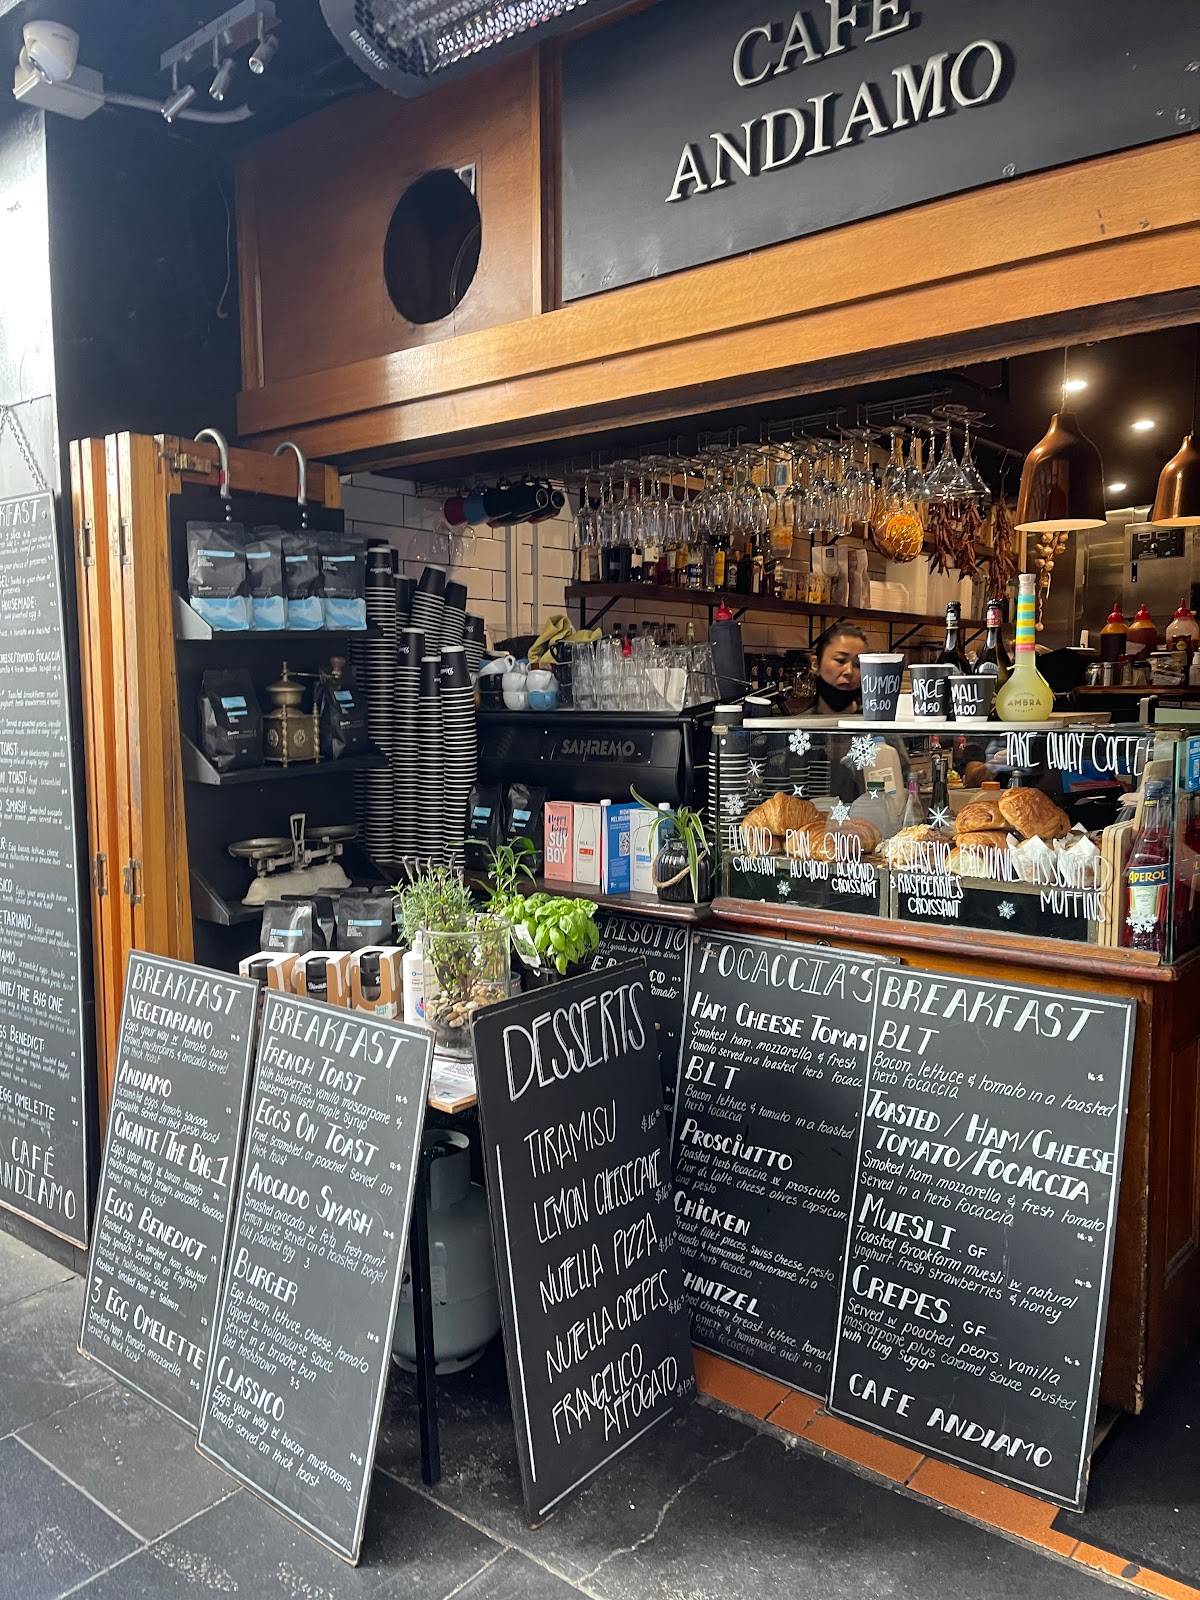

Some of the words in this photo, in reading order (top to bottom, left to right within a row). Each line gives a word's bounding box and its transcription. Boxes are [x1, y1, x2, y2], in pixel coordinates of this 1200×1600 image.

[349, 29, 389, 70] BROMIC
[664, 39, 1004, 203] ANDIAMO
[862, 675, 900, 694] JUMBO
[865, 699, 891, 712] $5.00
[912, 679, 945, 698] ARGE
[561, 739, 635, 757] SANREMO
[1000, 731, 1039, 767] TAKE
[1047, 733, 1085, 774] AWAY
[547, 848, 567, 864] BOY
[549, 832, 568, 848] SOY
[729, 825, 772, 855] ALMOND
[733, 857, 776, 877] CROISSANT
[803, 861, 828, 882] CHOCO
[837, 863, 874, 882] ALMOND
[832, 878, 876, 898] CROISSANT
[1129, 870, 1166, 882] APEROL
[898, 874, 963, 899] RASPBERRIES
[1041, 891, 1105, 922] MUFFINS
[908, 898, 961, 918] CROISSANT
[604, 917, 686, 951] RISOTTO
[132, 962, 241, 1015] BREAKFAST
[882, 976, 1104, 1041] BREAKFAST
[130, 994, 213, 1040] VEGETARIANO
[269, 1003, 409, 1069] BREAKFAST
[691, 992, 726, 1022] HAM
[736, 1003, 804, 1038] CHEESE
[878, 1020, 939, 1055] BLT
[503, 981, 646, 1101] DESSERTS
[690, 1039, 717, 1056] tomato
[719, 1048, 744, 1062] served
[762, 1058, 797, 1074] toasted
[802, 1065, 823, 1080] herb
[691, 1022, 726, 1042] Smoked
[758, 1040, 812, 1061] mozzarella
[828, 1054, 856, 1069] fresh
[118, 1060, 172, 1097] ANDIAMO
[263, 1036, 315, 1077] FRENCH
[319, 1056, 366, 1096] TOAST
[685, 1056, 740, 1090] BLT
[873, 1068, 898, 1084] herb
[903, 1075, 959, 1099] focaccia
[873, 1051, 911, 1072] Bacon
[919, 1060, 963, 1084] lettuce
[979, 1078, 1026, 1098] tomato
[1028, 1089, 1043, 1101] in
[1045, 1094, 1056, 1105] a
[1061, 1095, 1116, 1118] toasted
[15, 1093, 55, 1121] OMELETTE
[341, 1094, 390, 1124] mascarpone
[866, 1088, 941, 1132] TOASTED
[115, 1112, 160, 1154] GIGANTE
[189, 1143, 212, 1180] BIG
[255, 1098, 291, 1133] EGGS
[296, 1112, 319, 1144] ON
[325, 1122, 379, 1166] TOAST
[524, 1100, 616, 1178] TIRAMISU
[247, 1162, 310, 1210] AVOCADO
[316, 1185, 373, 1236] SMASH
[534, 1178, 588, 1244] LEMON
[594, 1147, 662, 1216] CHEESECAKE
[863, 1150, 902, 1176] Smoked
[937, 1177, 1001, 1204] mozzarella
[1022, 1199, 1054, 1218] fresh
[1062, 1208, 1105, 1232] tomato
[897, 1182, 908, 1195] in
[912, 1189, 920, 1199] a
[923, 1189, 951, 1208] herb
[955, 1200, 1014, 1226] focaccia
[104, 1187, 134, 1223] EGGS
[138, 1207, 207, 1262] BENEDICT
[540, 1244, 603, 1313] NUTELLA
[613, 1212, 657, 1275] PIZZA
[856, 1225, 896, 1250] Toasted
[899, 1237, 962, 1272] Brookfarm
[966, 1264, 1005, 1284] muesli
[1027, 1285, 1078, 1308] natural
[968, 1245, 987, 1258] GF
[233, 1247, 298, 1306] BURGER
[898, 1258, 925, 1277] fresh
[929, 1268, 1002, 1300] strawberries
[1019, 1298, 1062, 1324] honey
[91, 1277, 103, 1304] 3
[105, 1286, 130, 1321] EGG
[134, 1304, 205, 1370] OMELETTE
[852, 1264, 951, 1324] CREPES
[963, 1321, 987, 1337] GF
[547, 1306, 614, 1383] NUTELLA
[616, 1268, 669, 1330] CREPES
[847, 1297, 882, 1323] Served
[901, 1322, 952, 1348] poached
[1008, 1358, 1061, 1385] vanilla
[335, 1345, 369, 1373] tomato
[843, 1315, 904, 1347] mascarpone
[908, 1341, 936, 1359] plus
[940, 1352, 984, 1377] caramel
[989, 1371, 1022, 1391] sauce
[218, 1355, 285, 1421] CLASSICO
[552, 1344, 642, 1444] FRANGELICO
[849, 1373, 915, 1418] CAFE
[927, 1408, 1052, 1467] ANDIAMO
[307, 1453, 352, 1491] mushrooms
